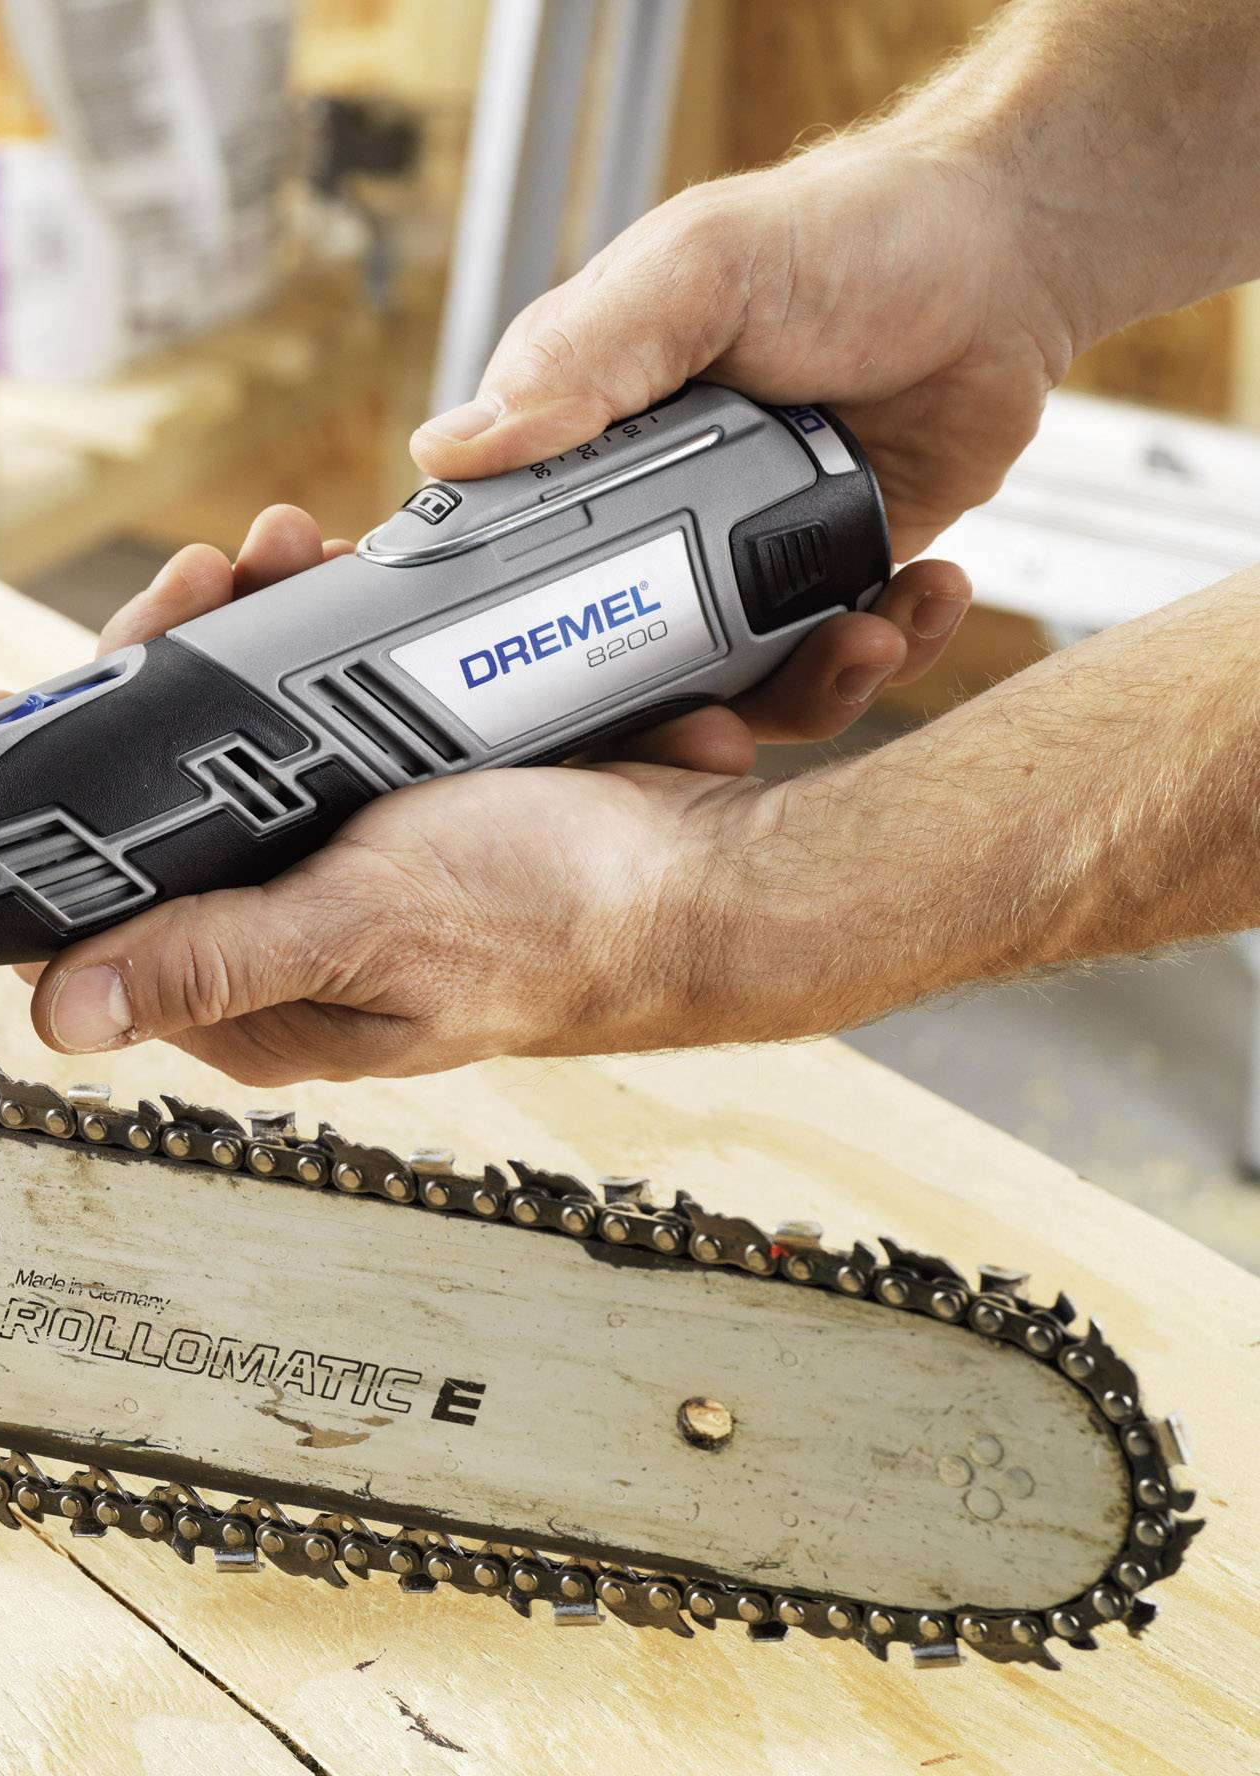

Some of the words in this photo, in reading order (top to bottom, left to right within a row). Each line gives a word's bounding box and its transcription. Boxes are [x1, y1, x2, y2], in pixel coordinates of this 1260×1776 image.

[622, 424, 642, 438] 10
[576, 443, 599, 460] 20
[530, 463, 552, 479] 30
[586, 620, 668, 668] 8200
[15, 1268, 66, 1292] Made
[68, 1277, 84, 1296] in
[88, 1282, 171, 1315] Germany
[430, 1377, 487, 1427] E
